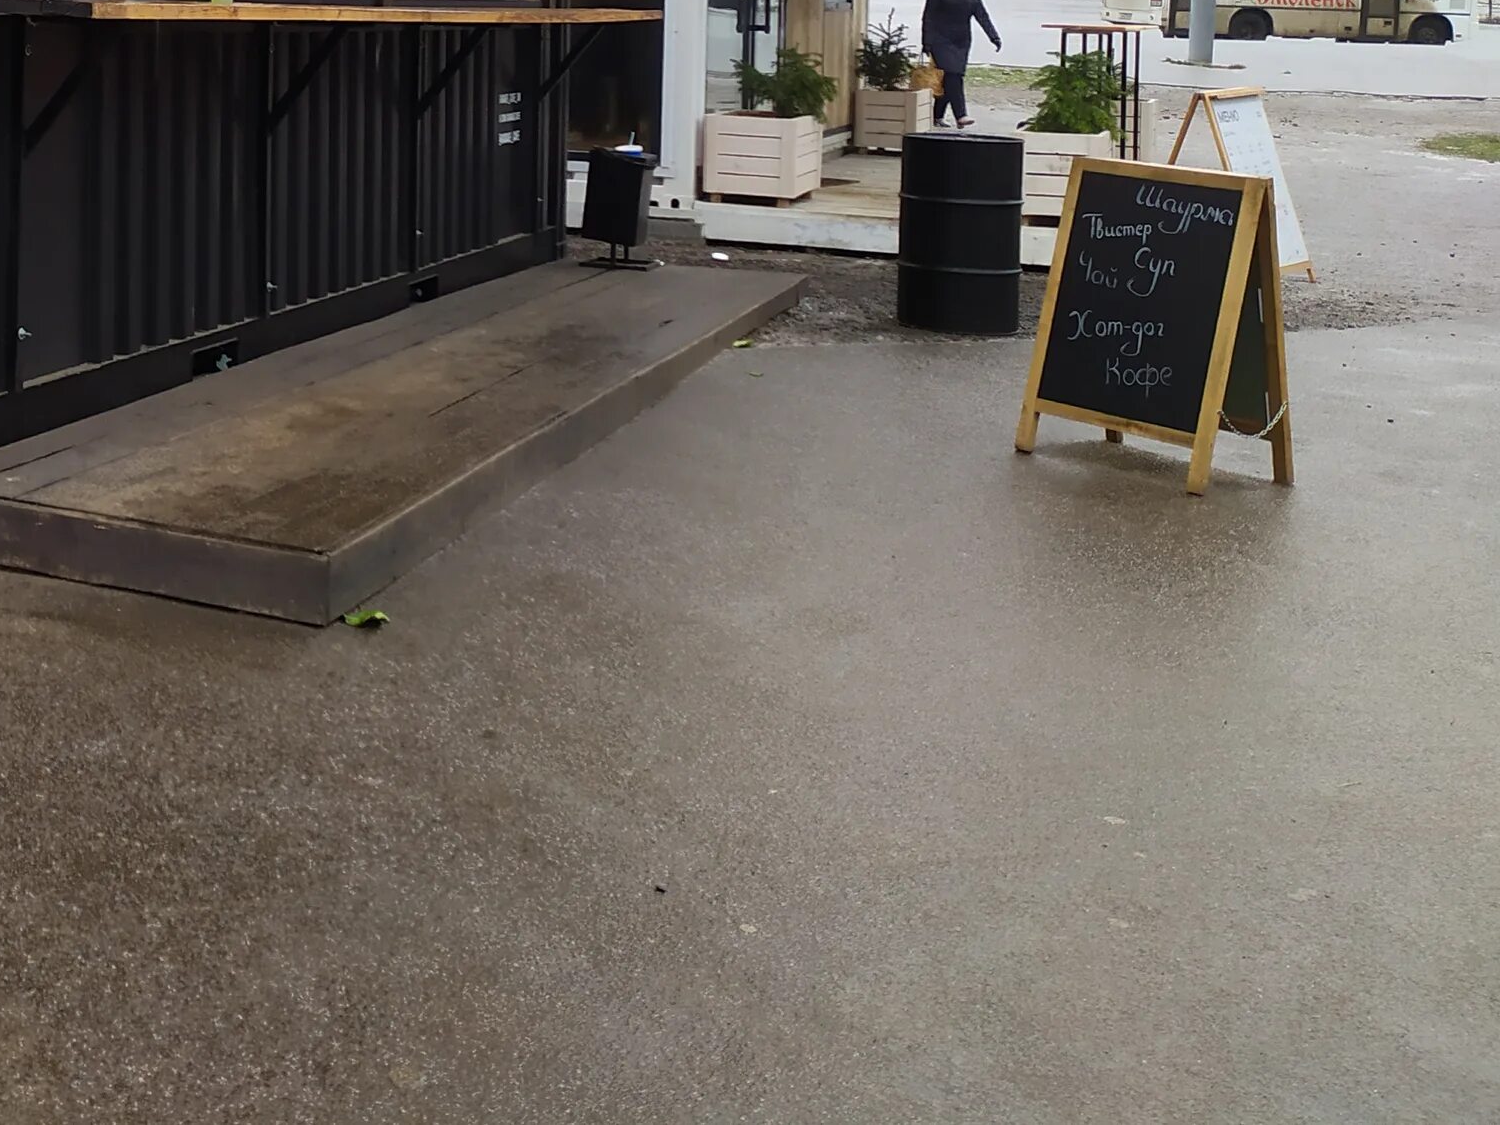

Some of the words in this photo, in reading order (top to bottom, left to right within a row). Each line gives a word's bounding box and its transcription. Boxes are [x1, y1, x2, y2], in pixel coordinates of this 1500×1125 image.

[1081, 213, 1153, 245] Твистер
[1135, 183, 1235, 235] Шаурма
[1126, 246, 1176, 297] Суп
[1067, 309, 1165, 357] Хот-дог
[1105, 357, 1173, 399] Кофе
